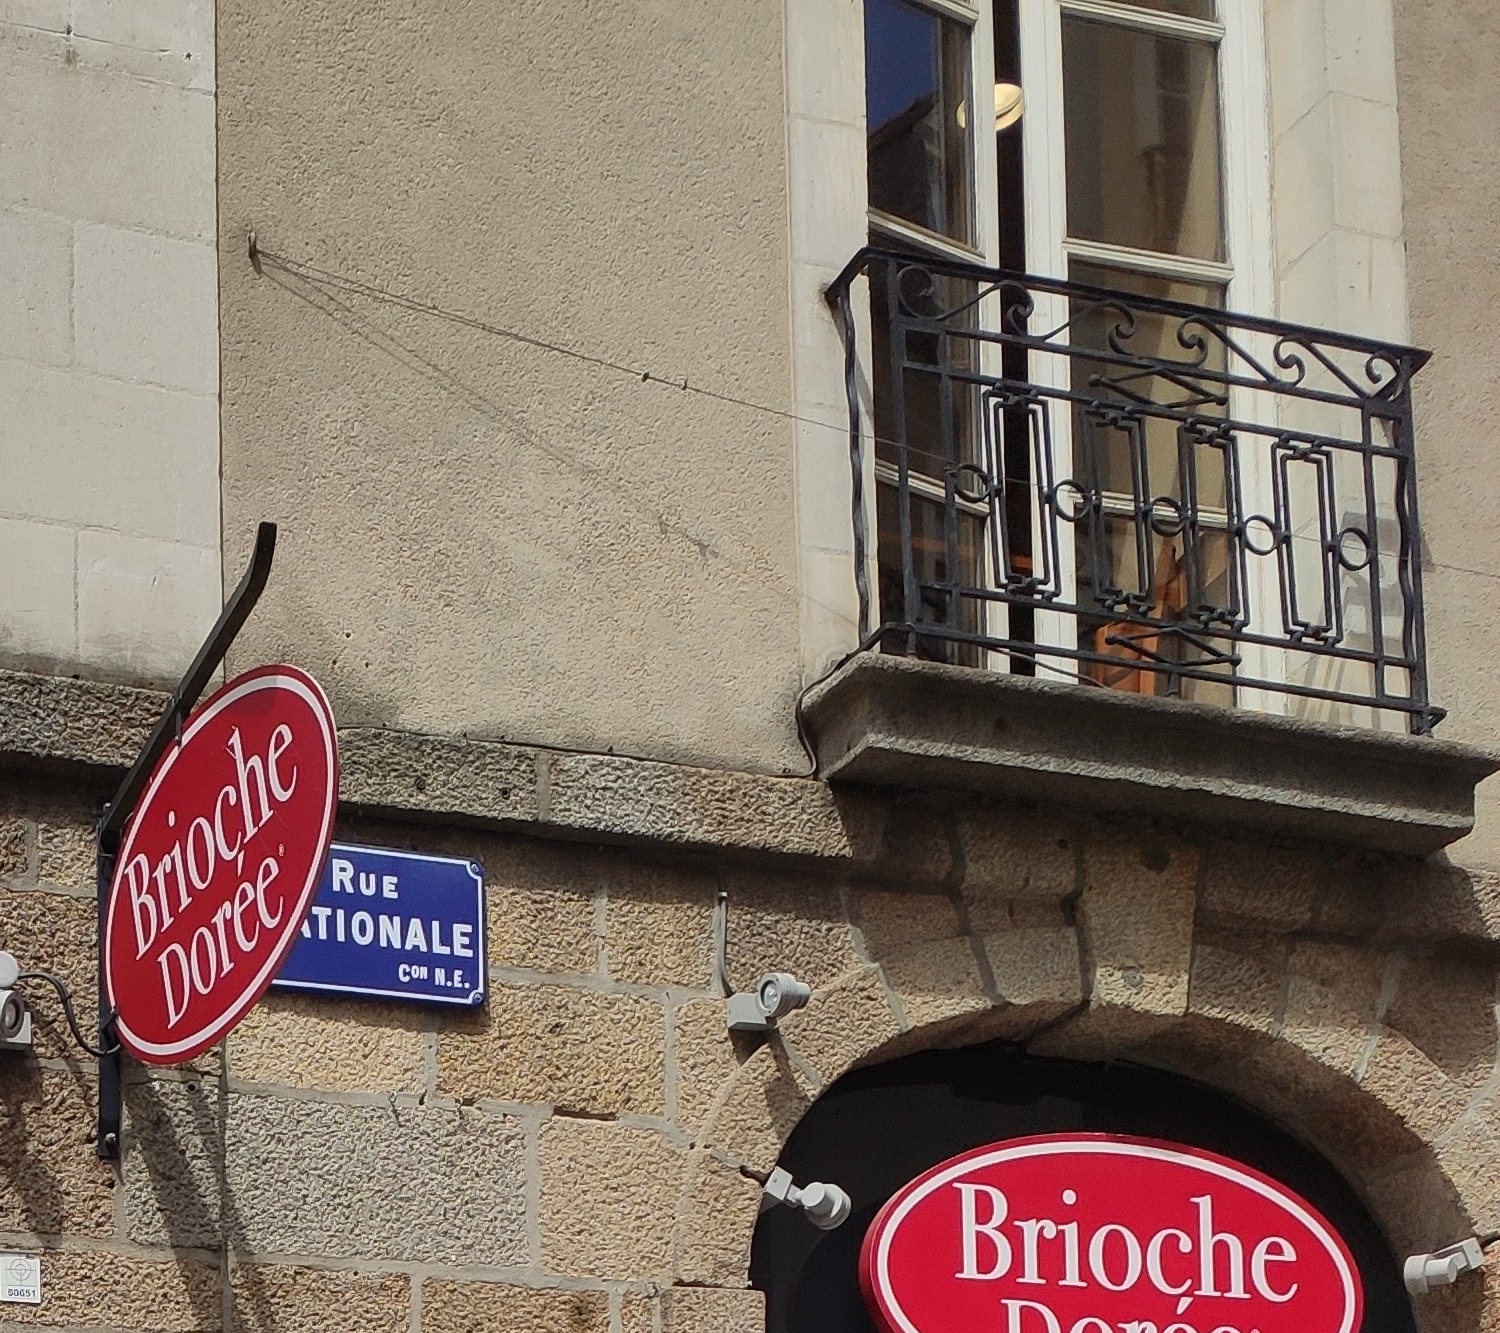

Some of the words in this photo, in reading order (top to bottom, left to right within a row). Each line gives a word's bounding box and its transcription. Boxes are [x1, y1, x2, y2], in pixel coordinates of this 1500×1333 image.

[123, 723, 298, 961] Brioche
[332, 858, 399, 899] RUE
[157, 848, 285, 1029] Dorée
[434, 967, 471, 989] N.E.
[953, 1182, 1299, 1303] Brioche
